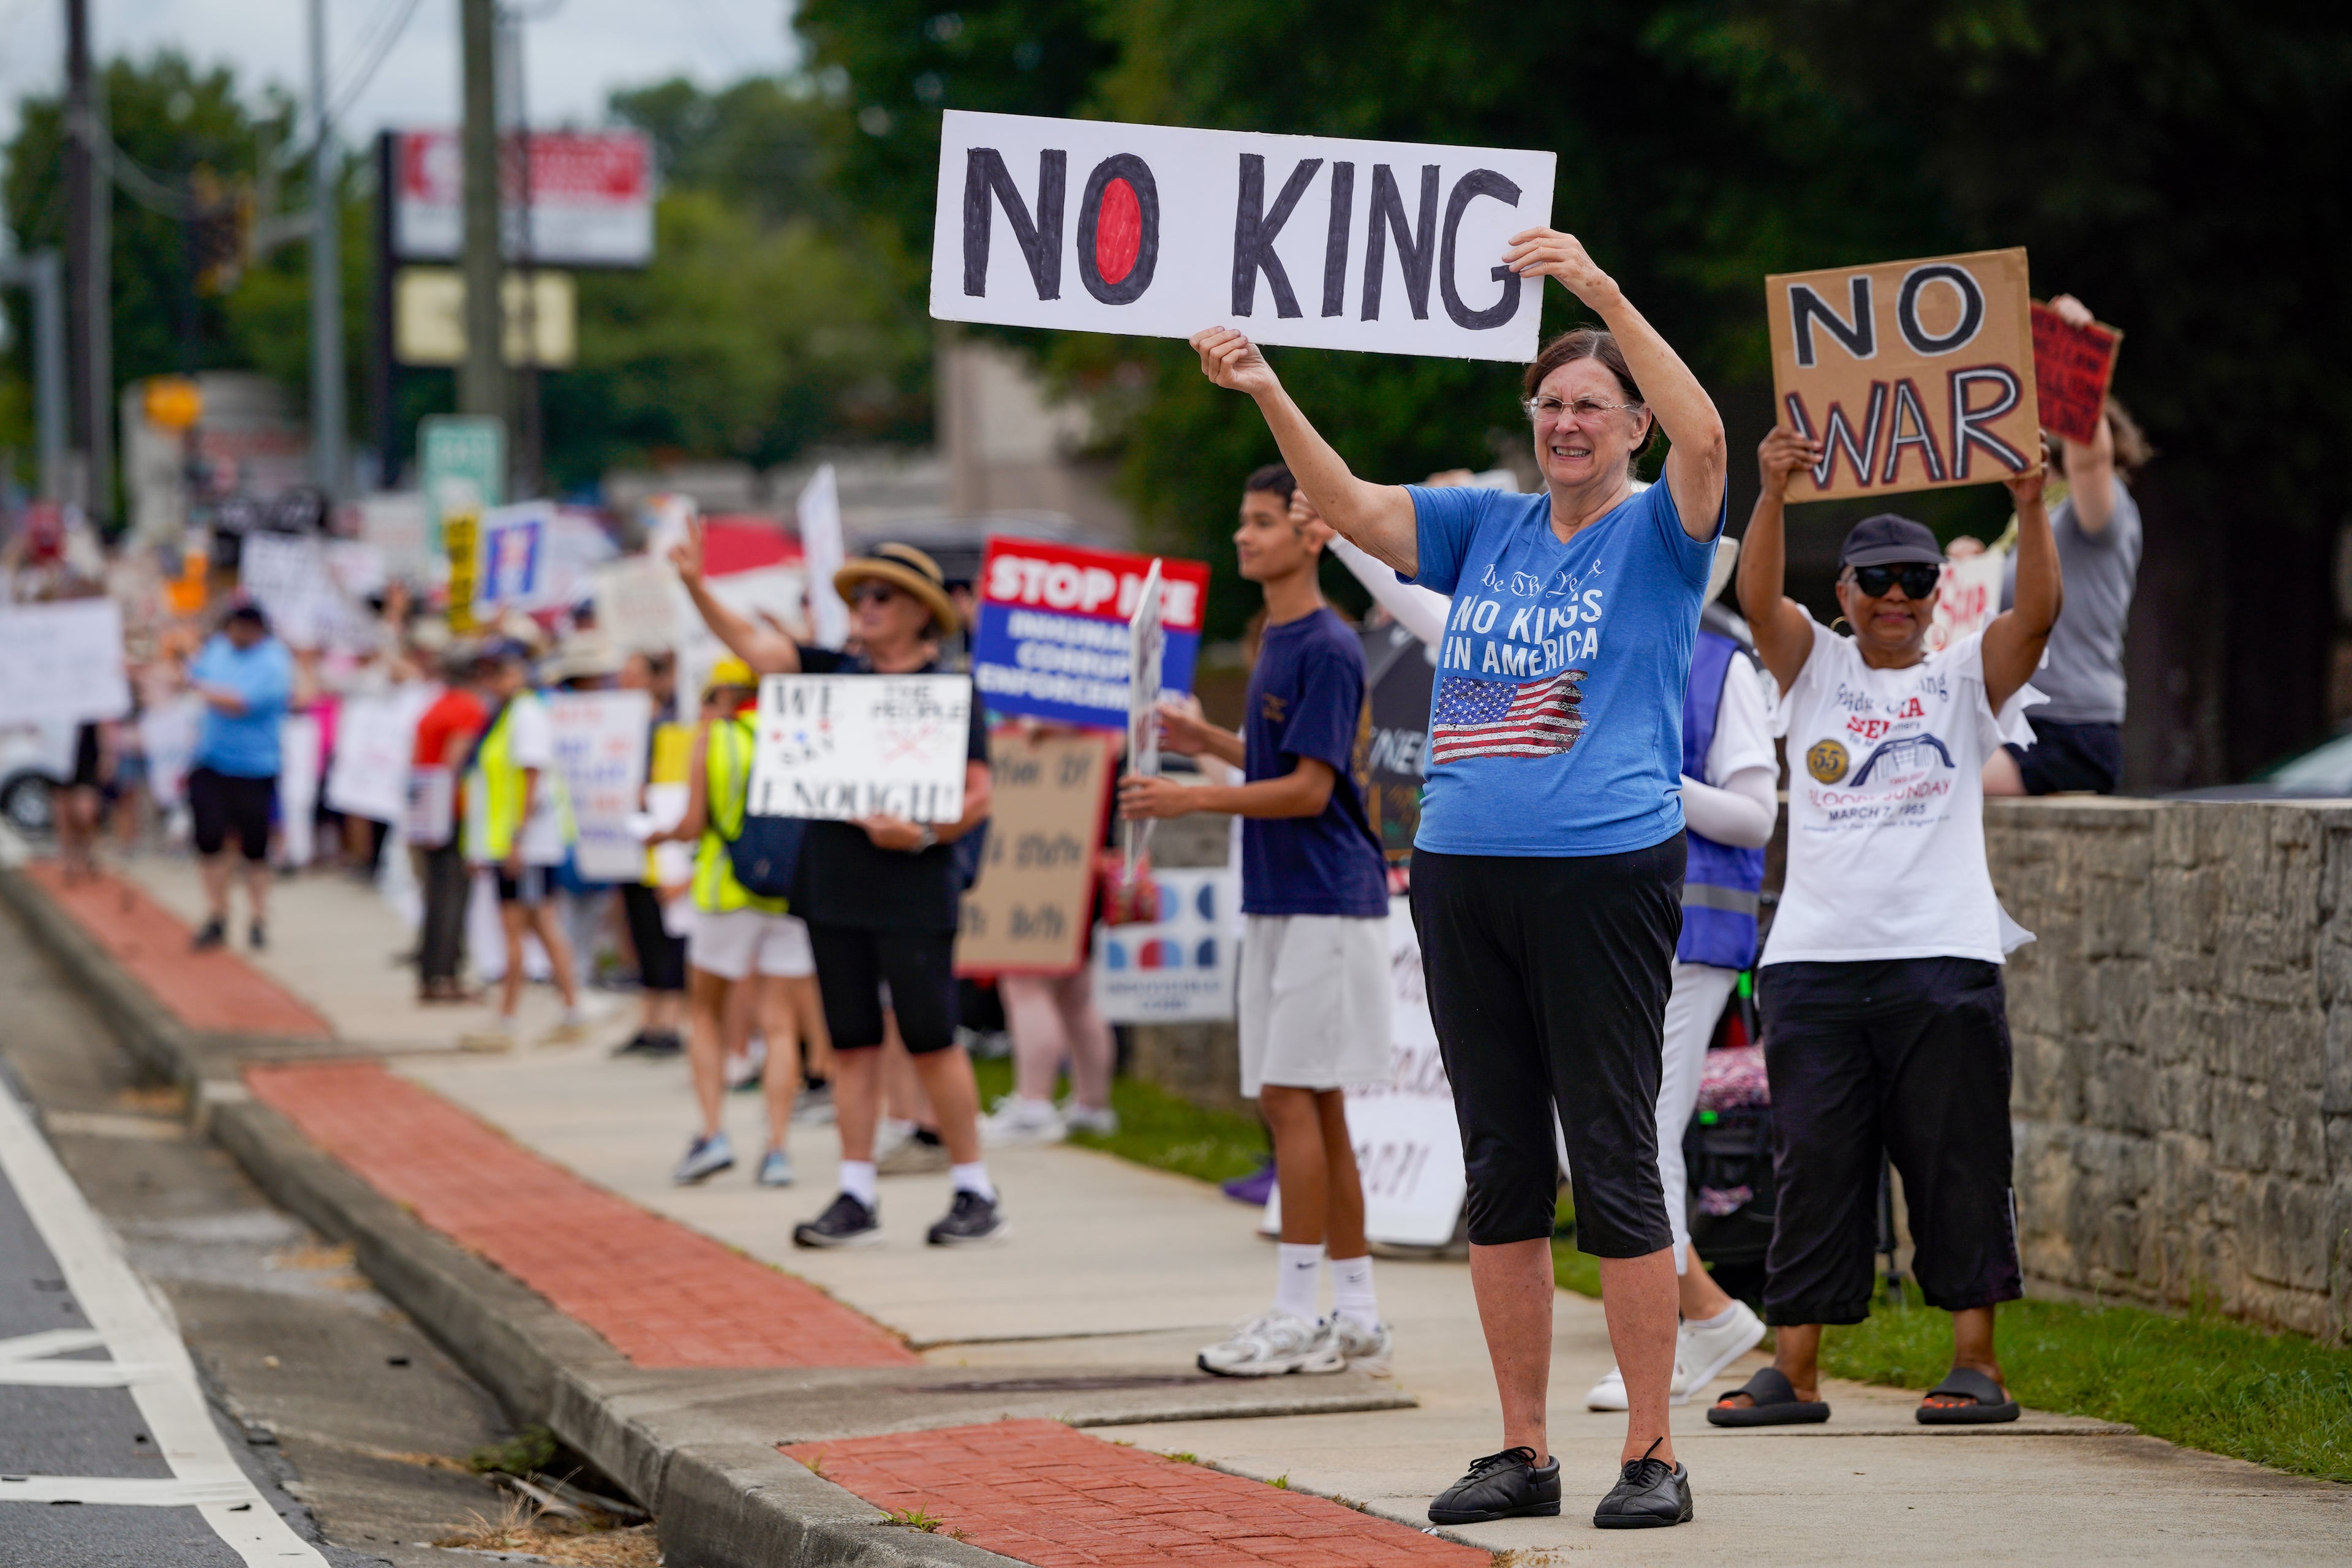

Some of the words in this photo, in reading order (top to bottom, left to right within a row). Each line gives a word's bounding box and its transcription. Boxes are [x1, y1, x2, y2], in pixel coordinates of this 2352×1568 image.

[963, 147, 1159, 305] NO
[1232, 152, 1522, 330] KING
[1788, 264, 1985, 368] NO
[1784, 363, 2032, 491] WAR
[989, 554, 1117, 612] STOP
[1451, 595, 1501, 634] NO
[1508, 589, 1603, 644] KINGS
[1444, 636, 1471, 670] IN
[1482, 627, 1598, 677] AMERICA
[1828, 807, 1879, 821] MARCH
